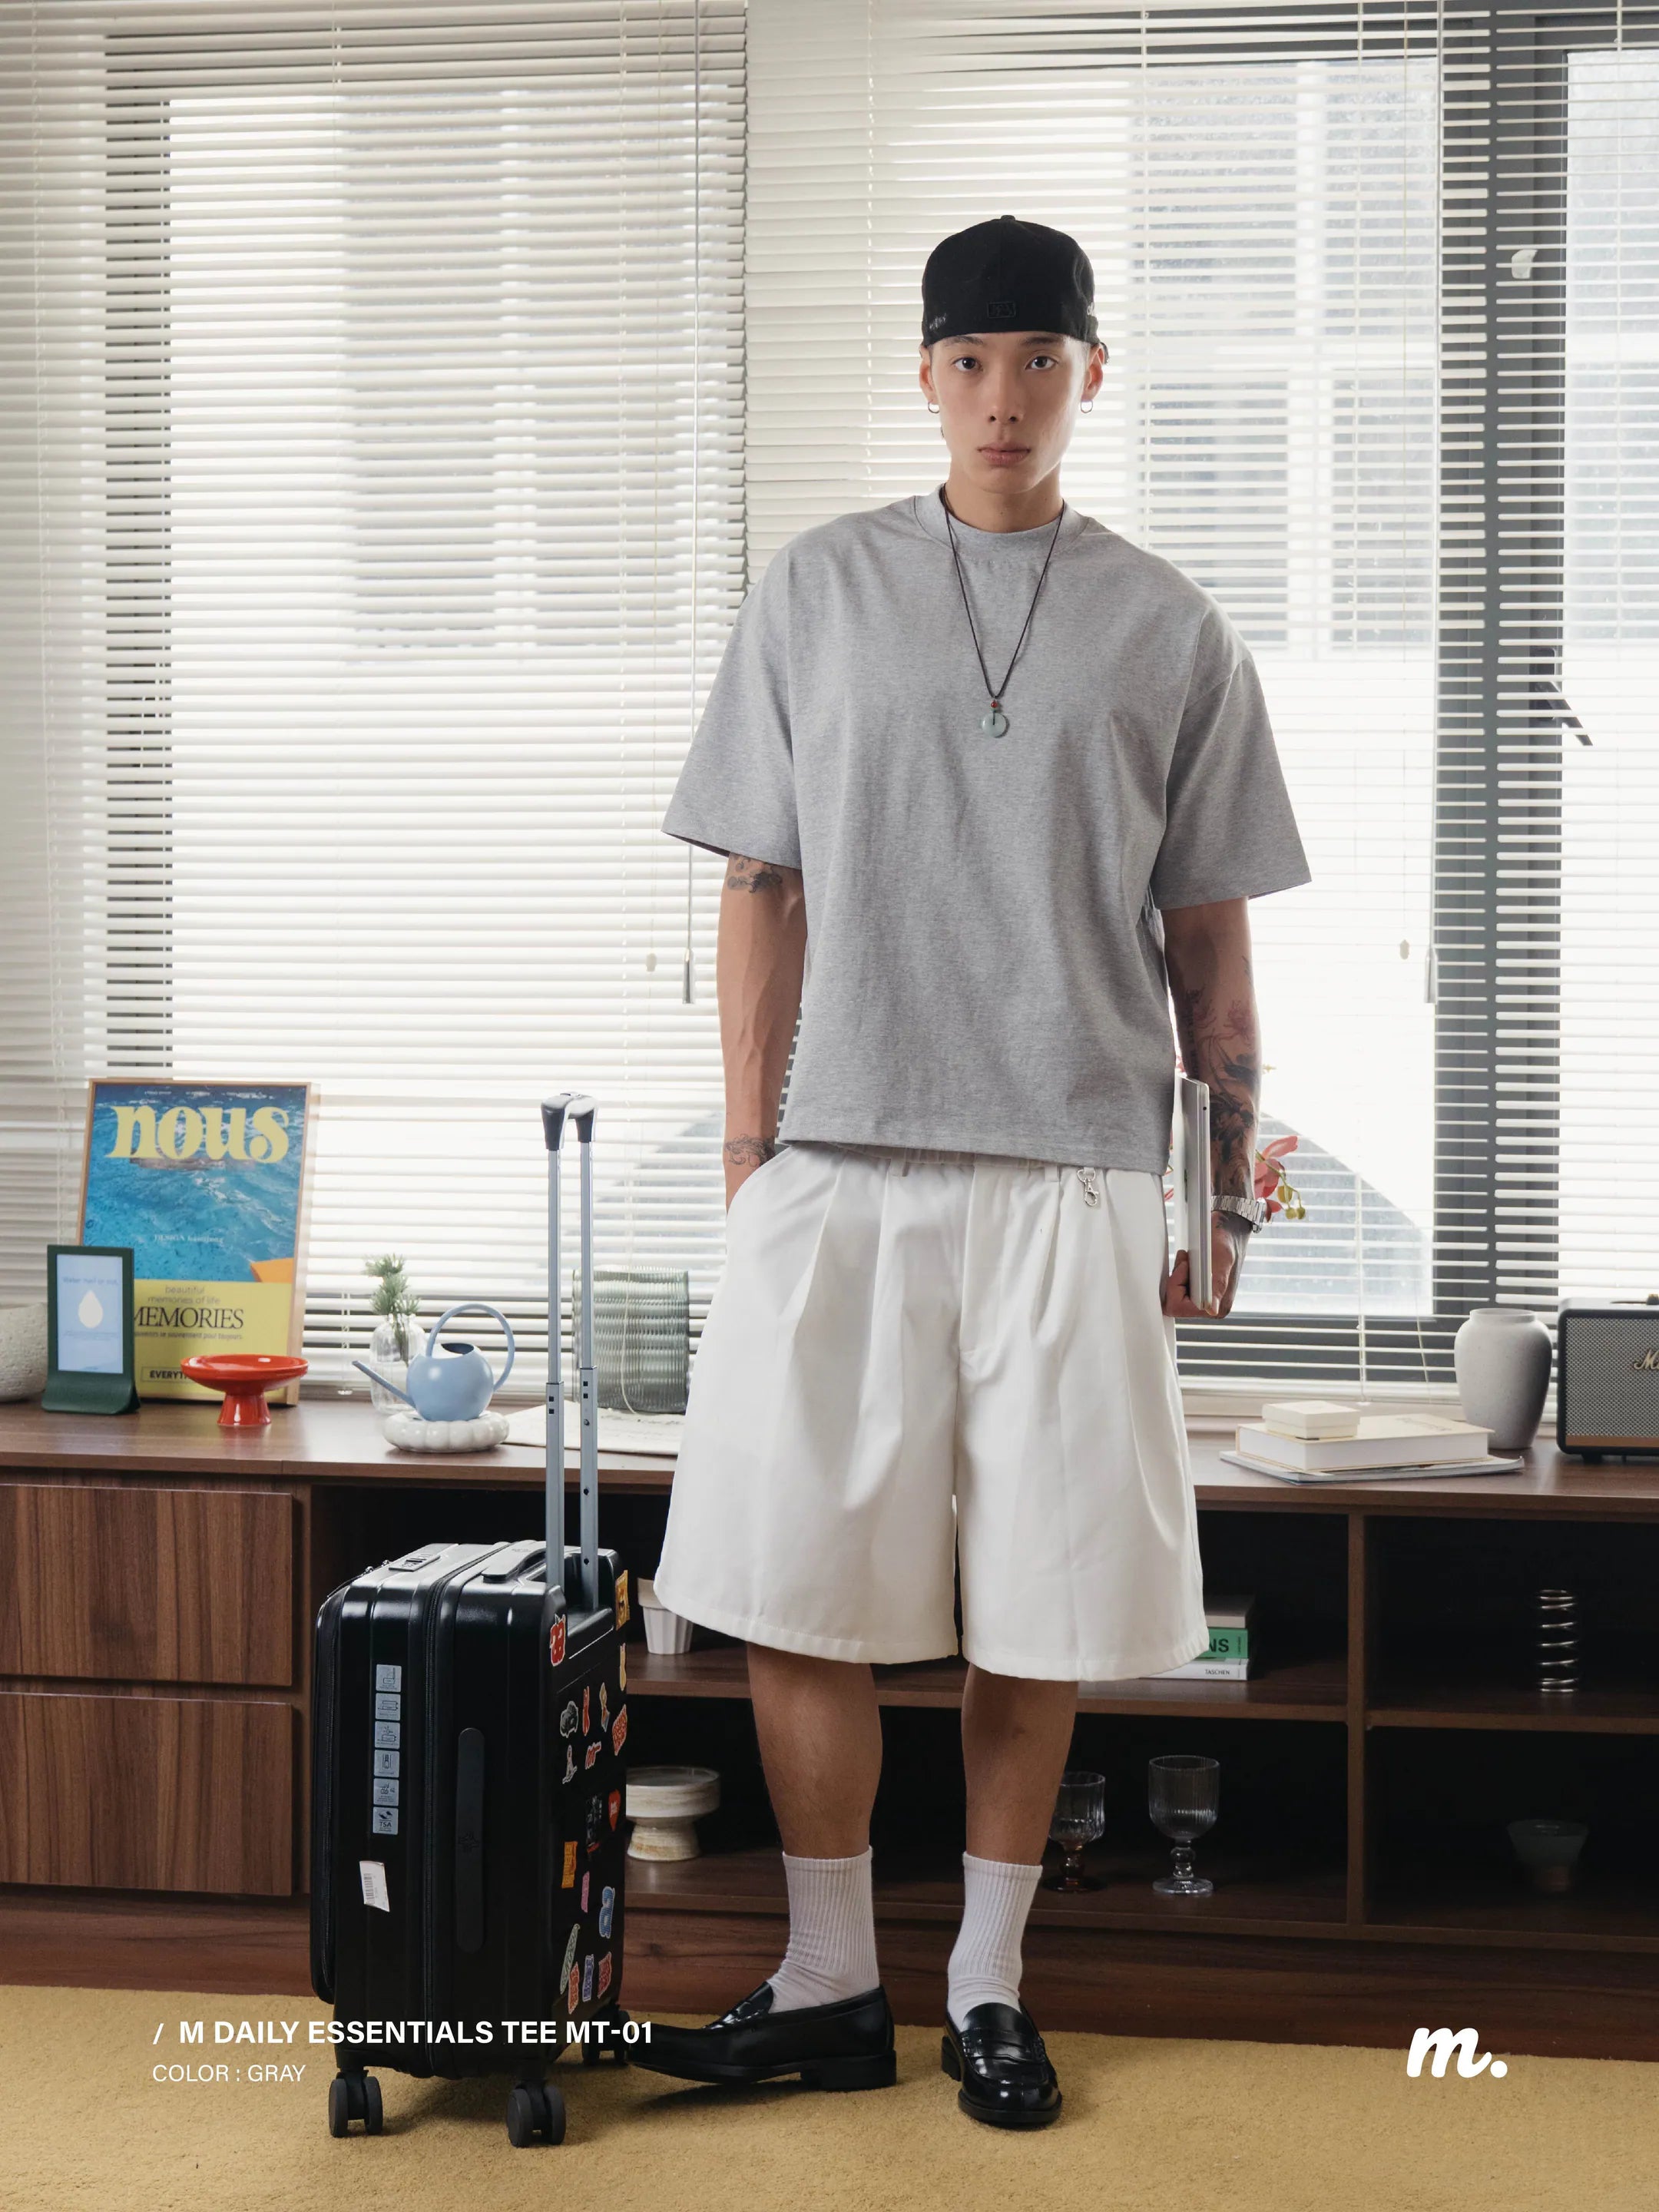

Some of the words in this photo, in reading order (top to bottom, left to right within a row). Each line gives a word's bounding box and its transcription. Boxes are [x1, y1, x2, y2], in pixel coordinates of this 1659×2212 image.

[104, 1105, 290, 1164] nous
[164, 1285, 205, 1294] beautiful
[147, 1296, 193, 1304] memories
[195, 1296, 205, 1304] of
[207, 1296, 221, 1305] life
[149, 1369, 187, 1380] EVERYT
